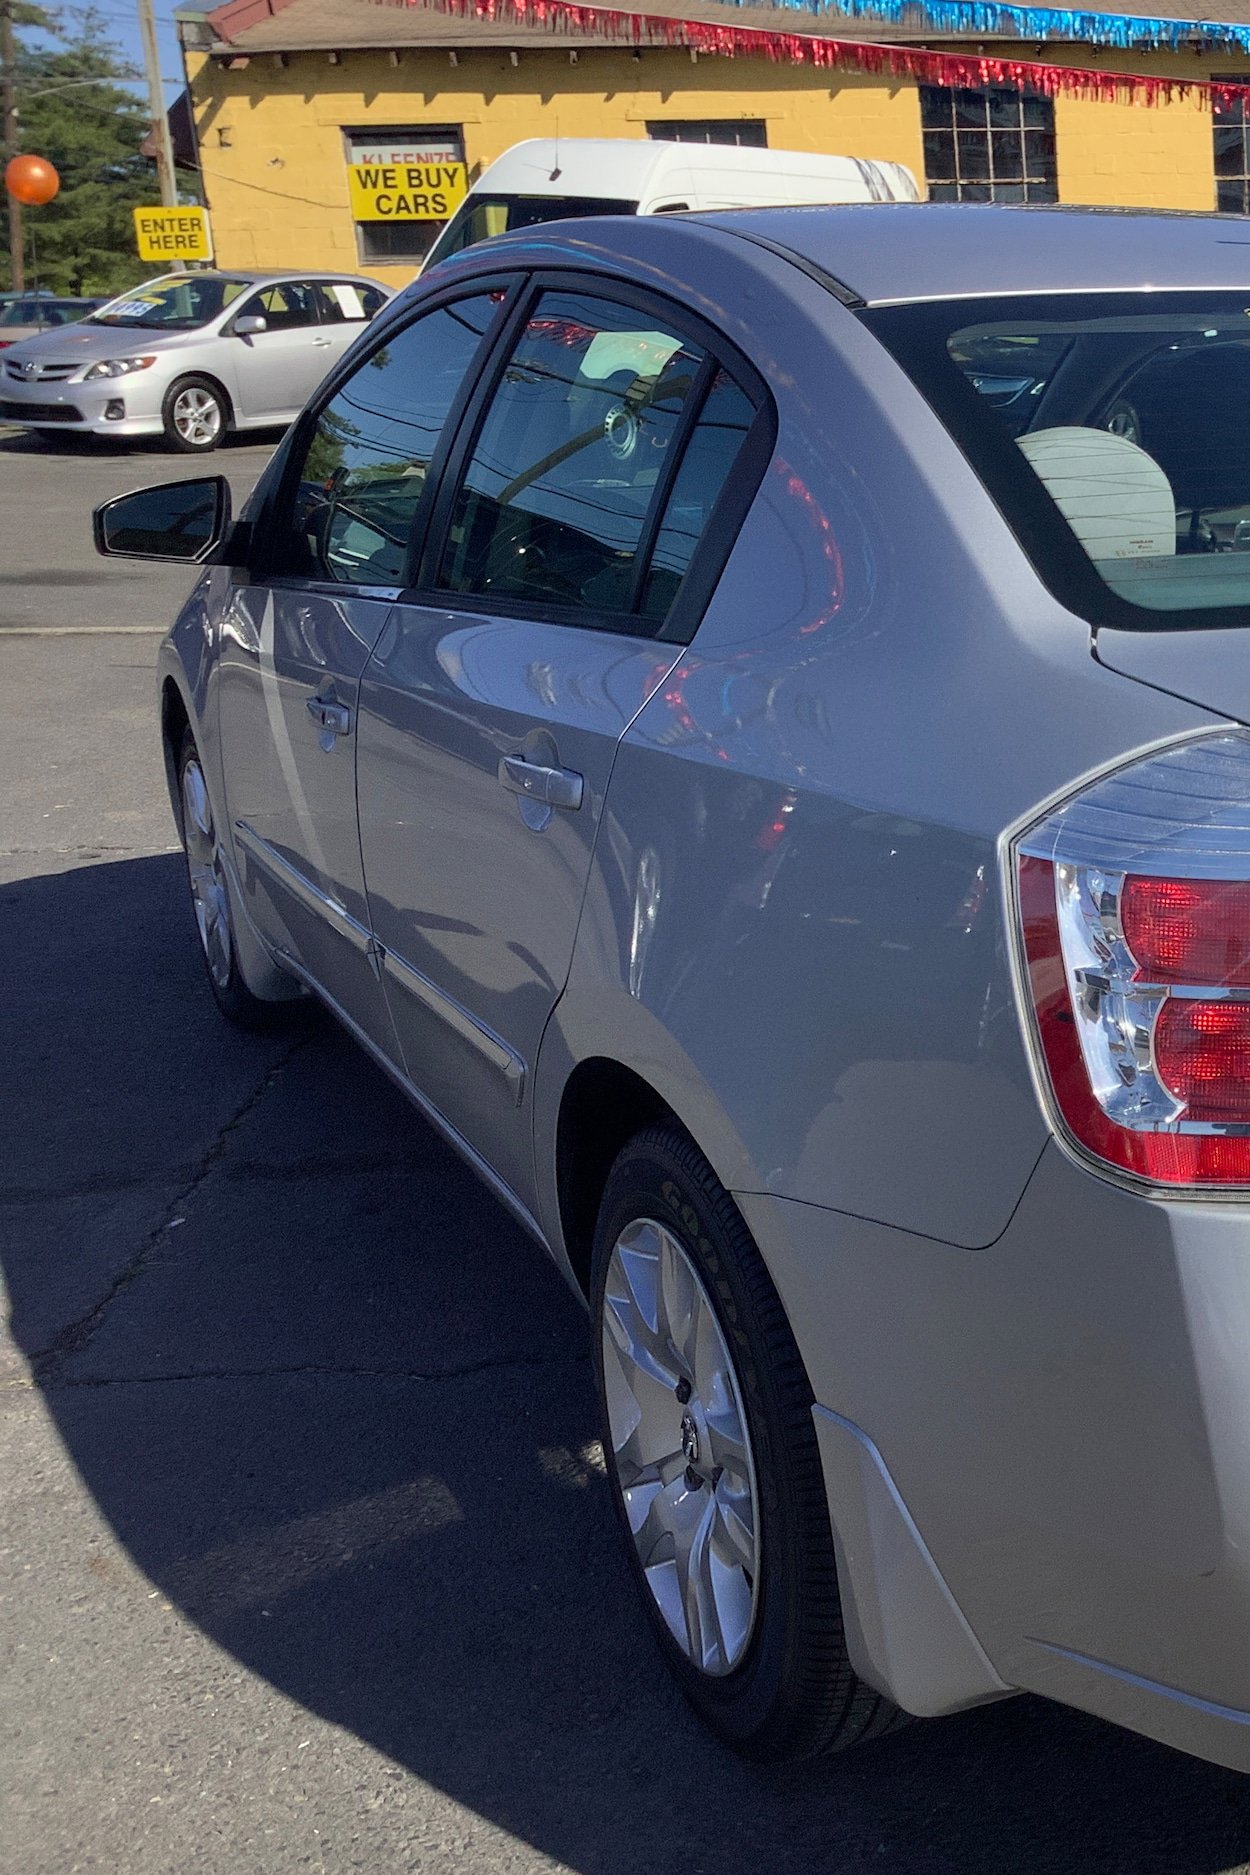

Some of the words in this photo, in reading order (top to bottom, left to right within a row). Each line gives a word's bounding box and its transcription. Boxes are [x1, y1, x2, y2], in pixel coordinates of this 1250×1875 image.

[356, 168, 398, 189] WE
[406, 167, 459, 188] BUY
[375, 193, 448, 215] CARS
[140, 217, 202, 233] ENTER
[148, 234, 200, 250] HERE
